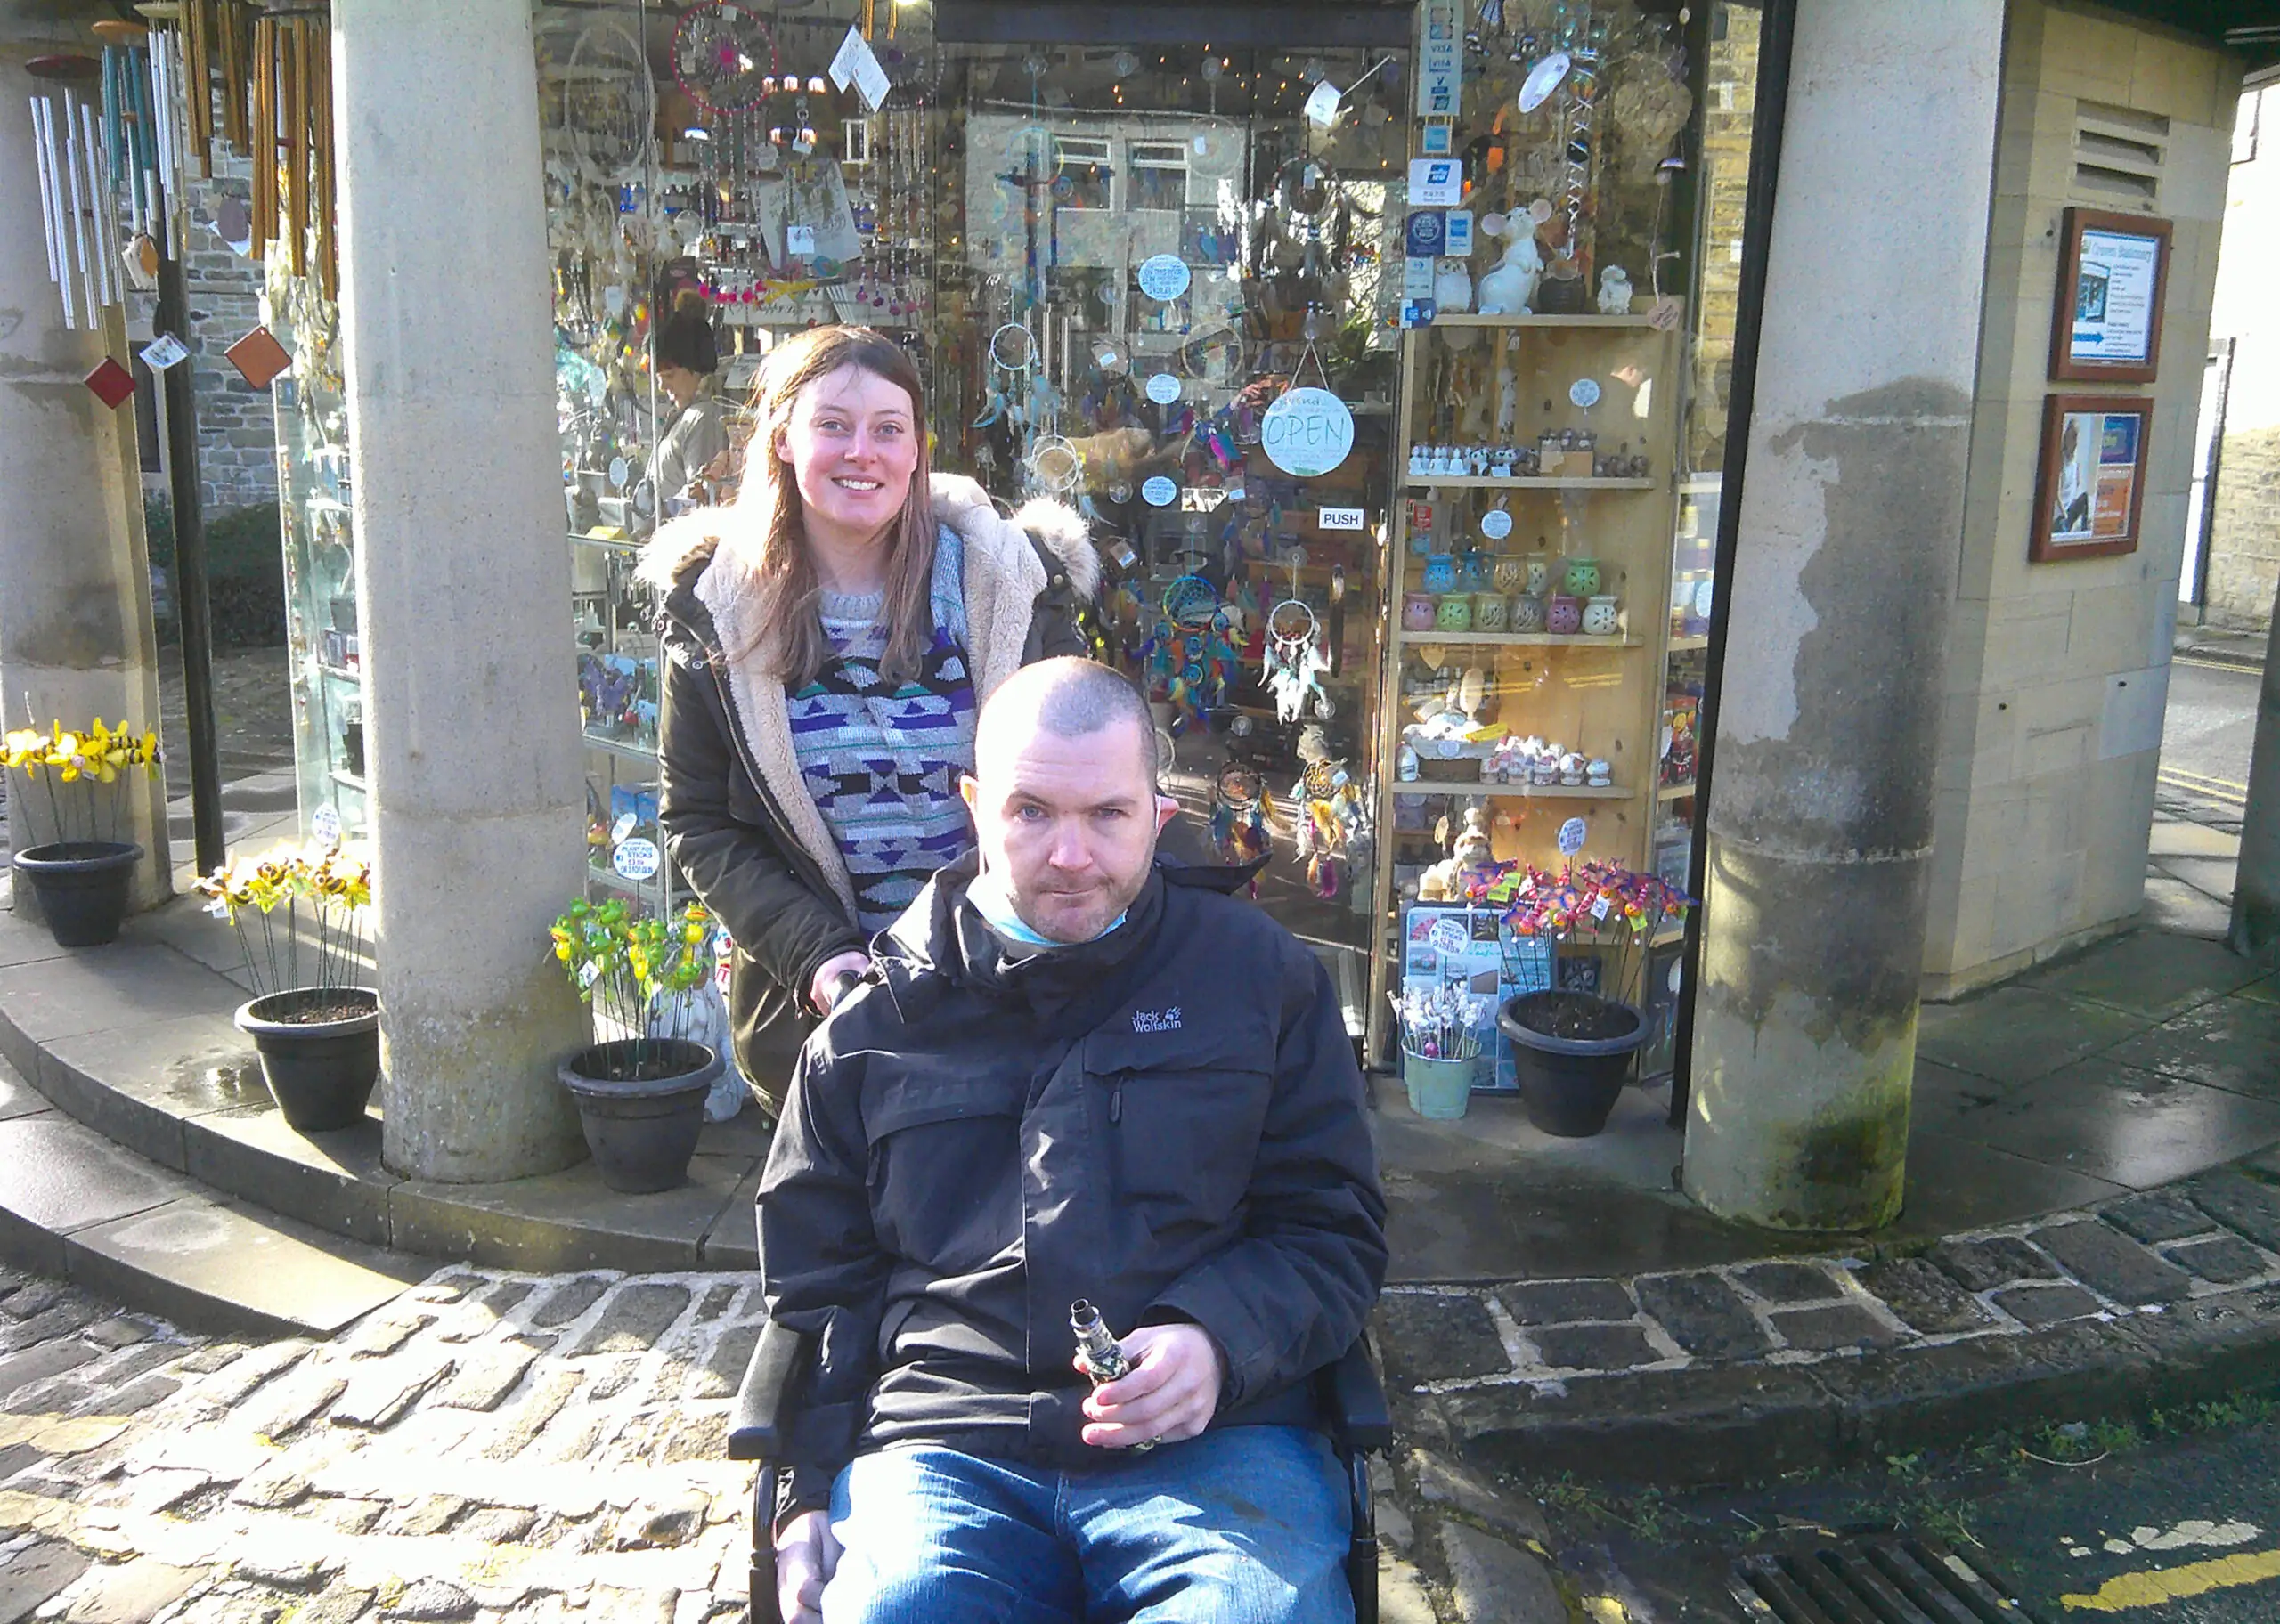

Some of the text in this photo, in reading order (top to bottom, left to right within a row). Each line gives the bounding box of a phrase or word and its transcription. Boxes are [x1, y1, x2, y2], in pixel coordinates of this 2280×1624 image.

[1266, 414, 1345, 448] OPEN
[1323, 513, 1359, 525] PUSH
[1132, 1010, 1160, 1021] Jack
[1133, 1019, 1182, 1033] Wolfskin
